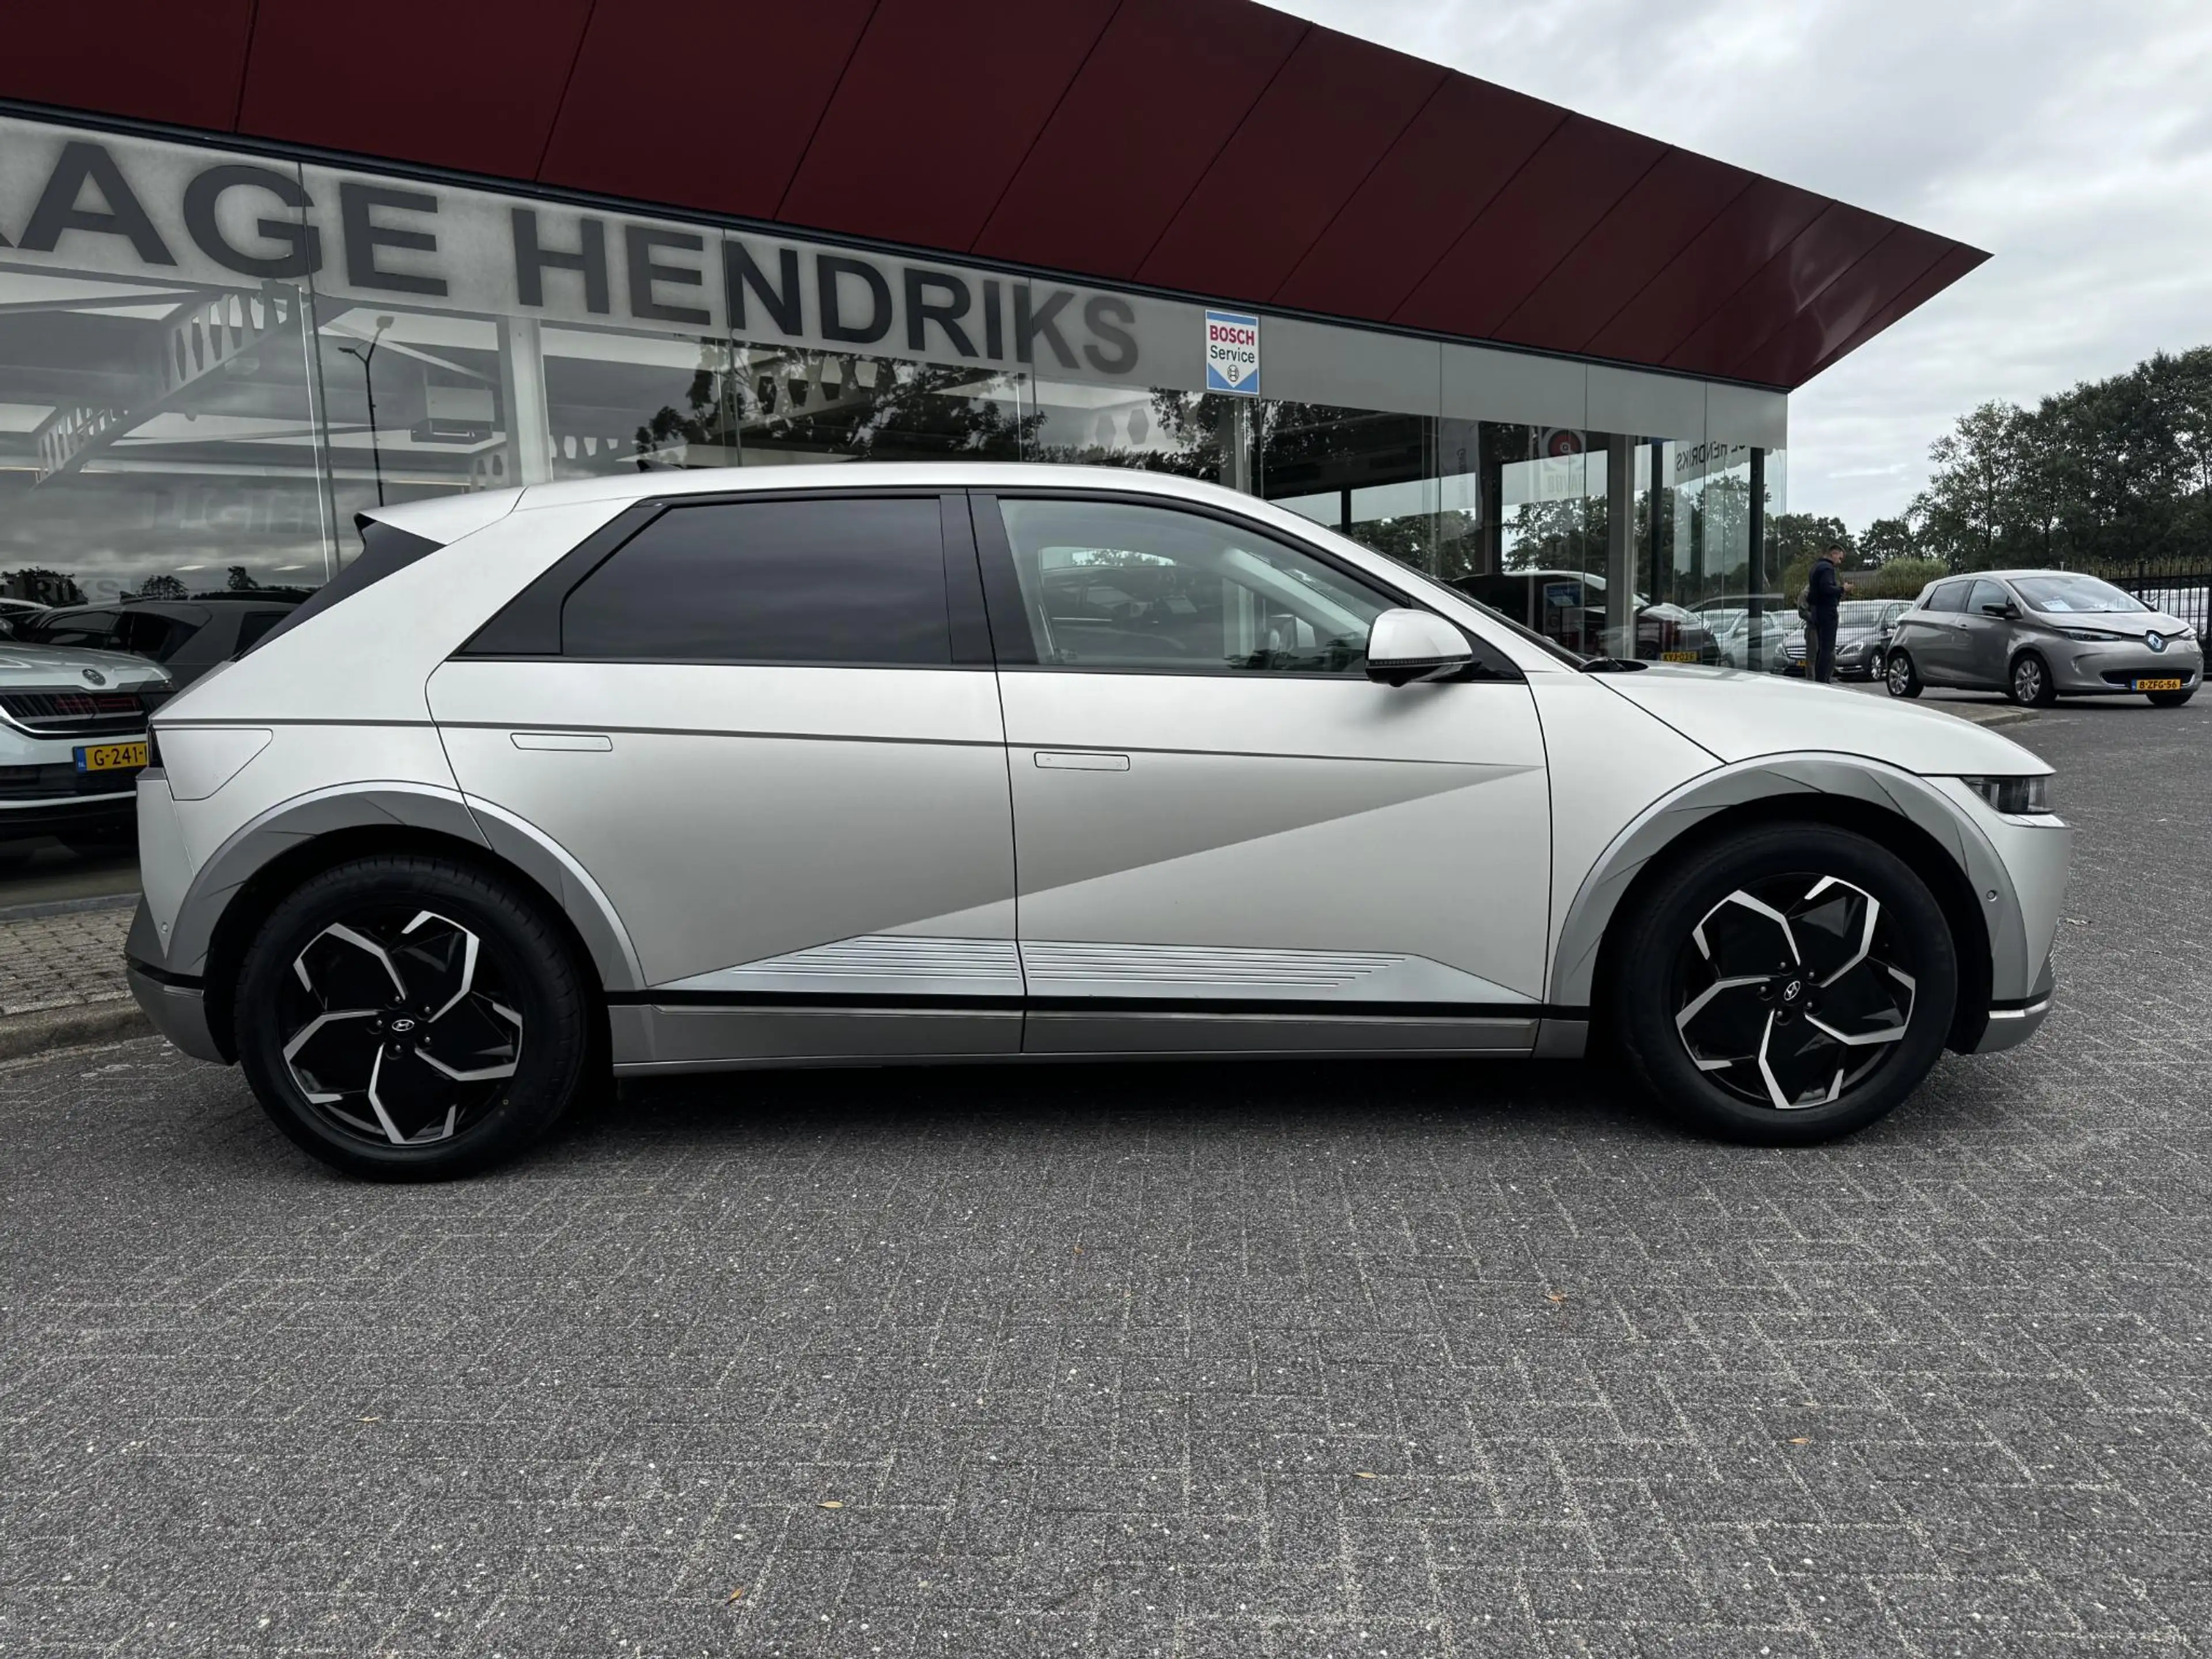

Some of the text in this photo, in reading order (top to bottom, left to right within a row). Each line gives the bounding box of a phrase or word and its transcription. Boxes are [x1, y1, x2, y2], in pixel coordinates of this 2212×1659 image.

[0, 141, 1139, 374] AGE HENDRIKS
[1210, 325, 1255, 346] BOSCH
[1210, 344, 1255, 363] Service
[94, 746, 147, 767] G-241-
